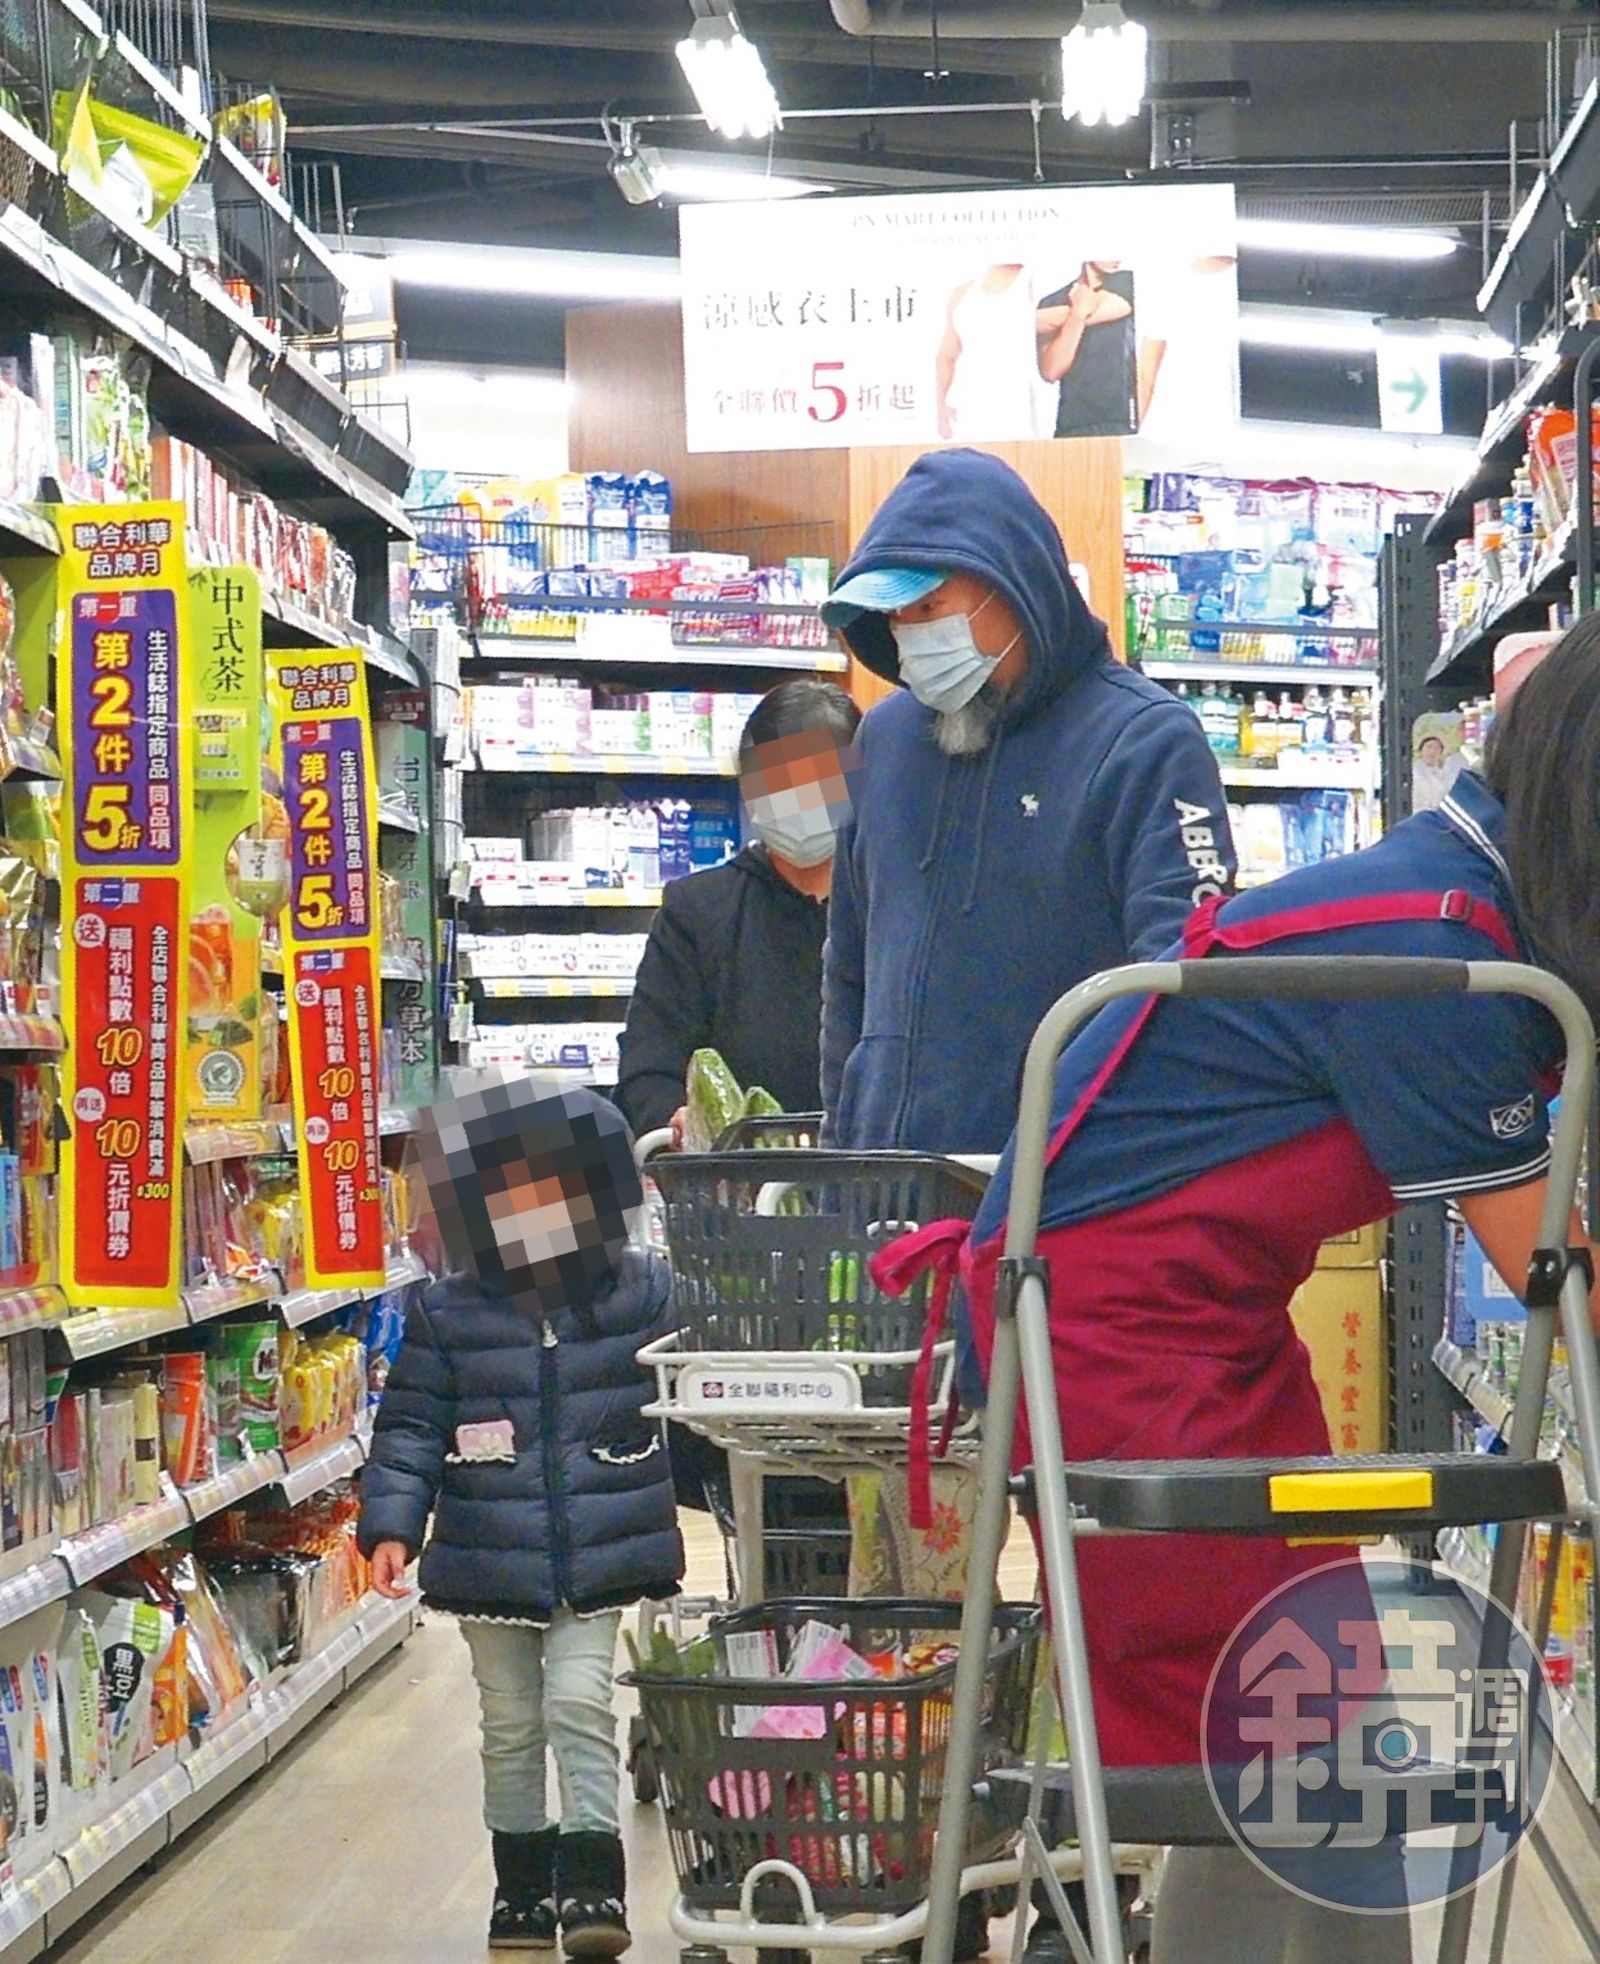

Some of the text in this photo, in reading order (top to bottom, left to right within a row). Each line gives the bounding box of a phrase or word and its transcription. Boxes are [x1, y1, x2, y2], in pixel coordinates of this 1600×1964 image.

[703, 285, 918, 329] 涼感衣上市
[74, 520, 170, 548] 聯合利華
[90, 551, 160, 577] 品牌月
[80, 596, 137, 617] 第一重
[212, 578, 244, 692] 中式茶
[280, 664, 356, 687] 聯合利華
[294, 688, 349, 710] 品牌月
[286, 723, 332, 743] 第一重
[84, 883, 140, 904] 第二重
[78, 918, 101, 942] 送
[300, 953, 344, 971] 第二重
[298, 980, 317, 1004] 送
[728, 1382, 832, 1398] 全聯福利中心
